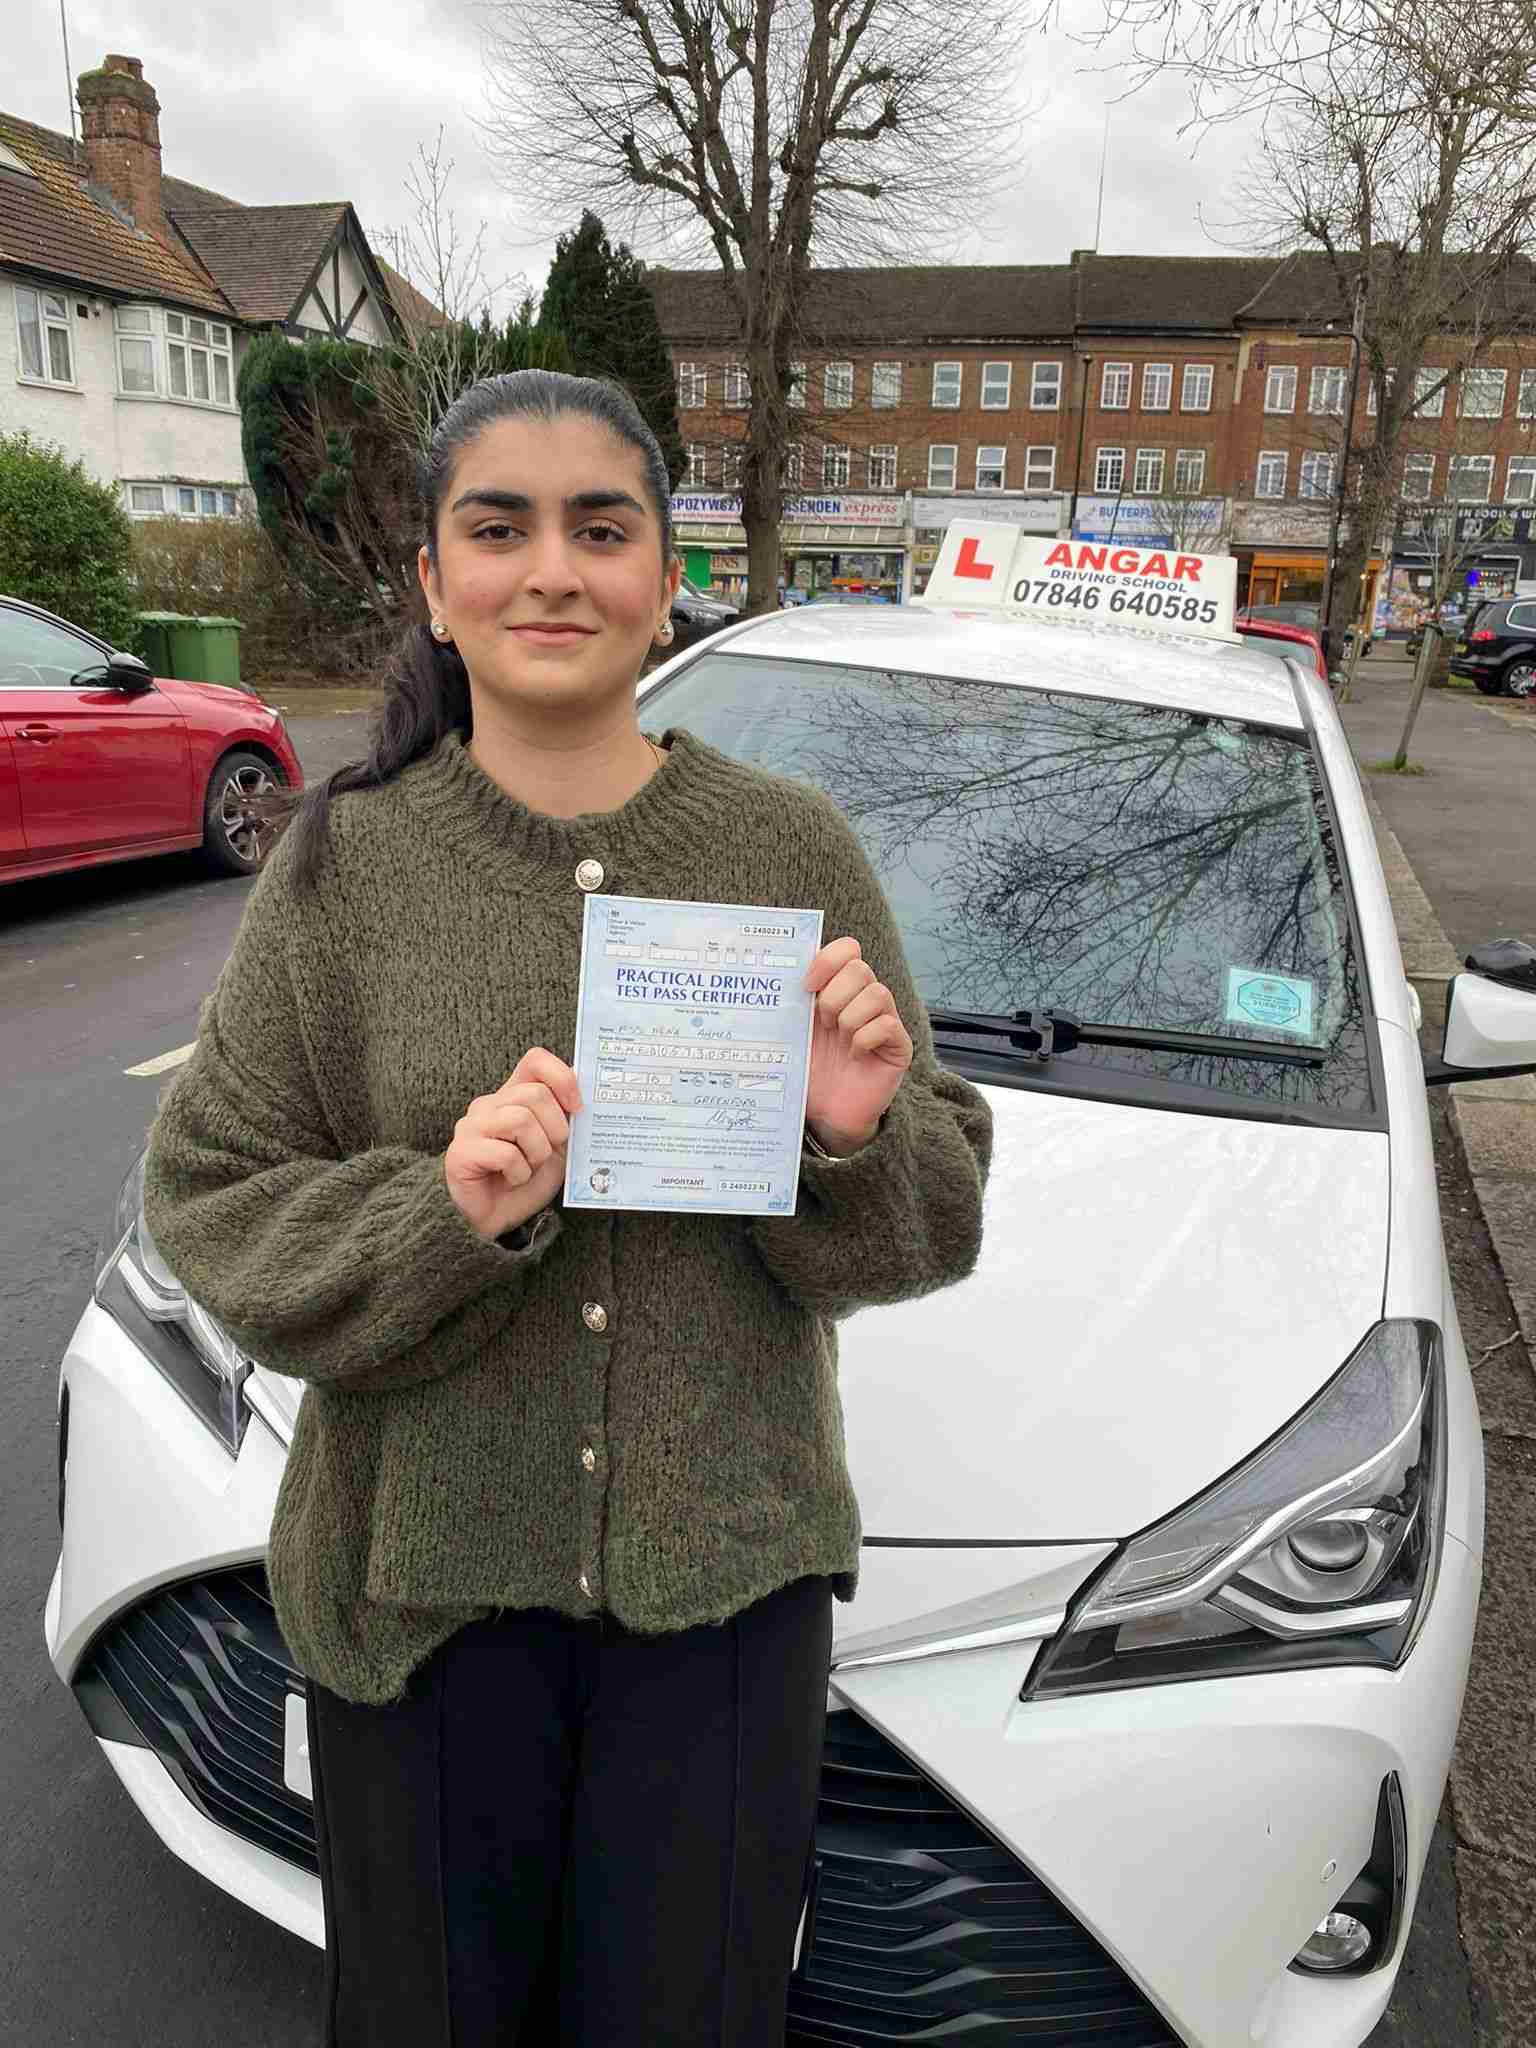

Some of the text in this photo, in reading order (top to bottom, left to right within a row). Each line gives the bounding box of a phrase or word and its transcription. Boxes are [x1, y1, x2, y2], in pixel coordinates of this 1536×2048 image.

[954, 538, 994, 580] L
[1044, 543, 1204, 582] ANGAR
[1050, 568, 1187, 593] DRIVING SCHOOL
[1013, 579, 1219, 624] 07846 640585
[616, 967, 782, 992] PRACTICAL DRIVING
[616, 984, 780, 1007] TEST PASS CERTIFICATE
[661, 1176, 705, 1187] IMPORTANT
